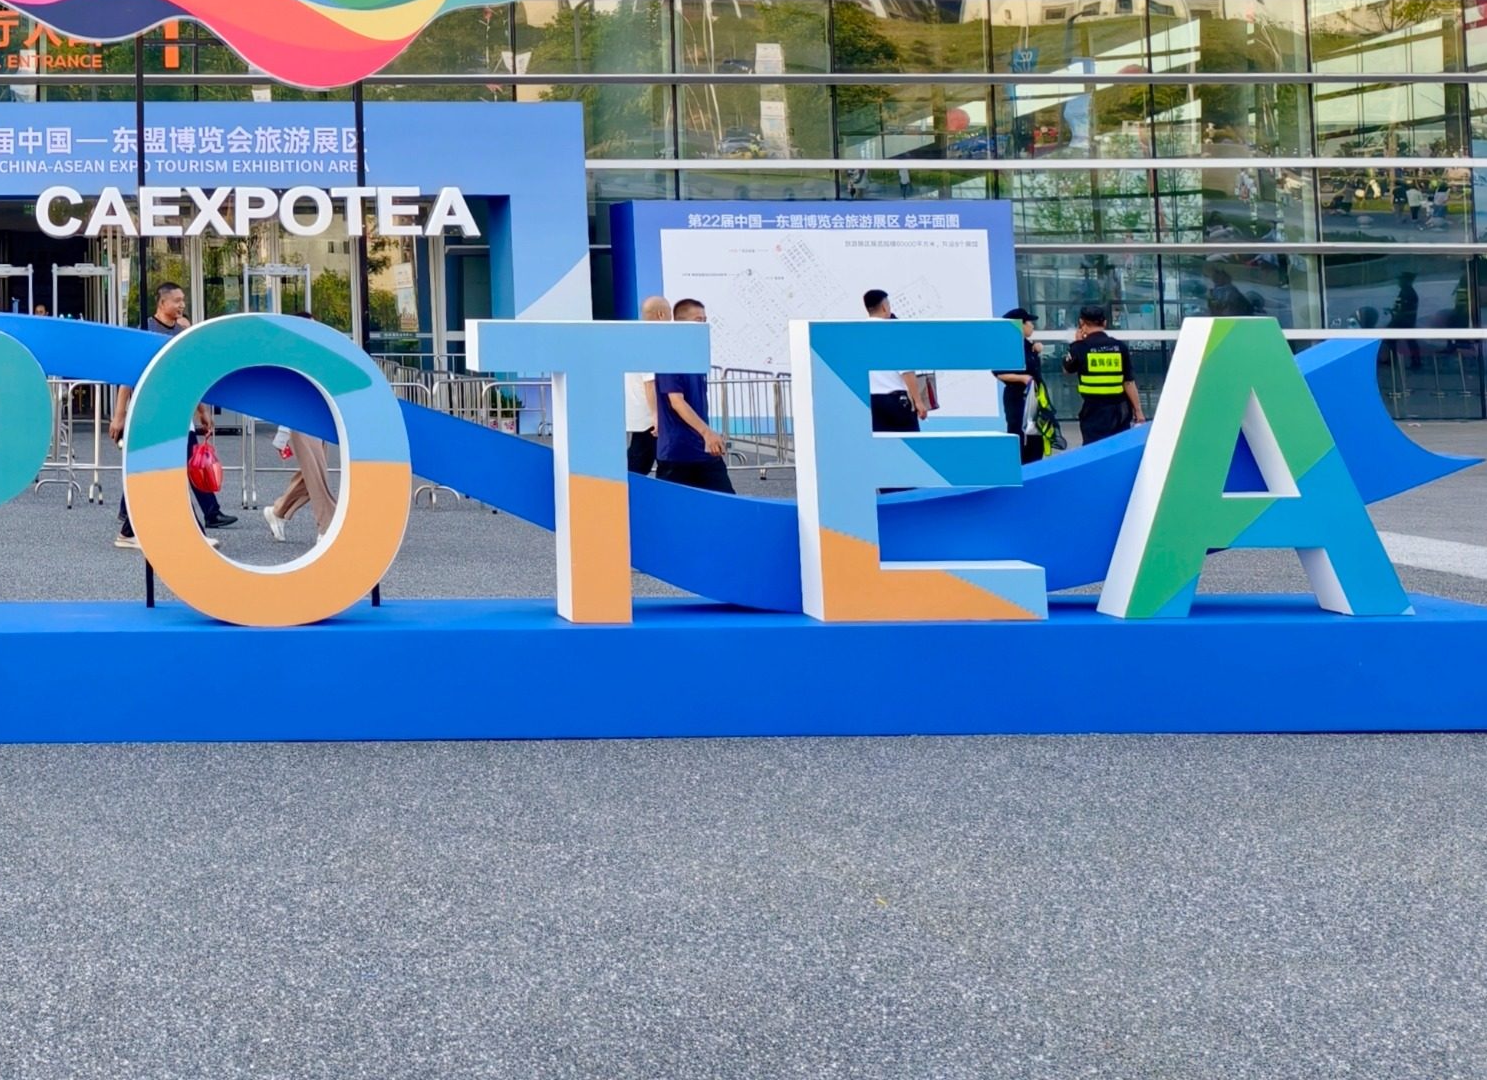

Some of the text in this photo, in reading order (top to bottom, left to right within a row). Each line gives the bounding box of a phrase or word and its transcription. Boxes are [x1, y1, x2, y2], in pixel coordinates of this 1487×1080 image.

[7, 54, 103, 68] ENTRANCE
[109, 159, 151, 173] EXPO
[155, 159, 228, 173] TOURISM
[232, 159, 323, 173] EXHIBITION
[34, 185, 482, 239] CAEXPOTEA
[904, 213, 960, 229] 总平面图
